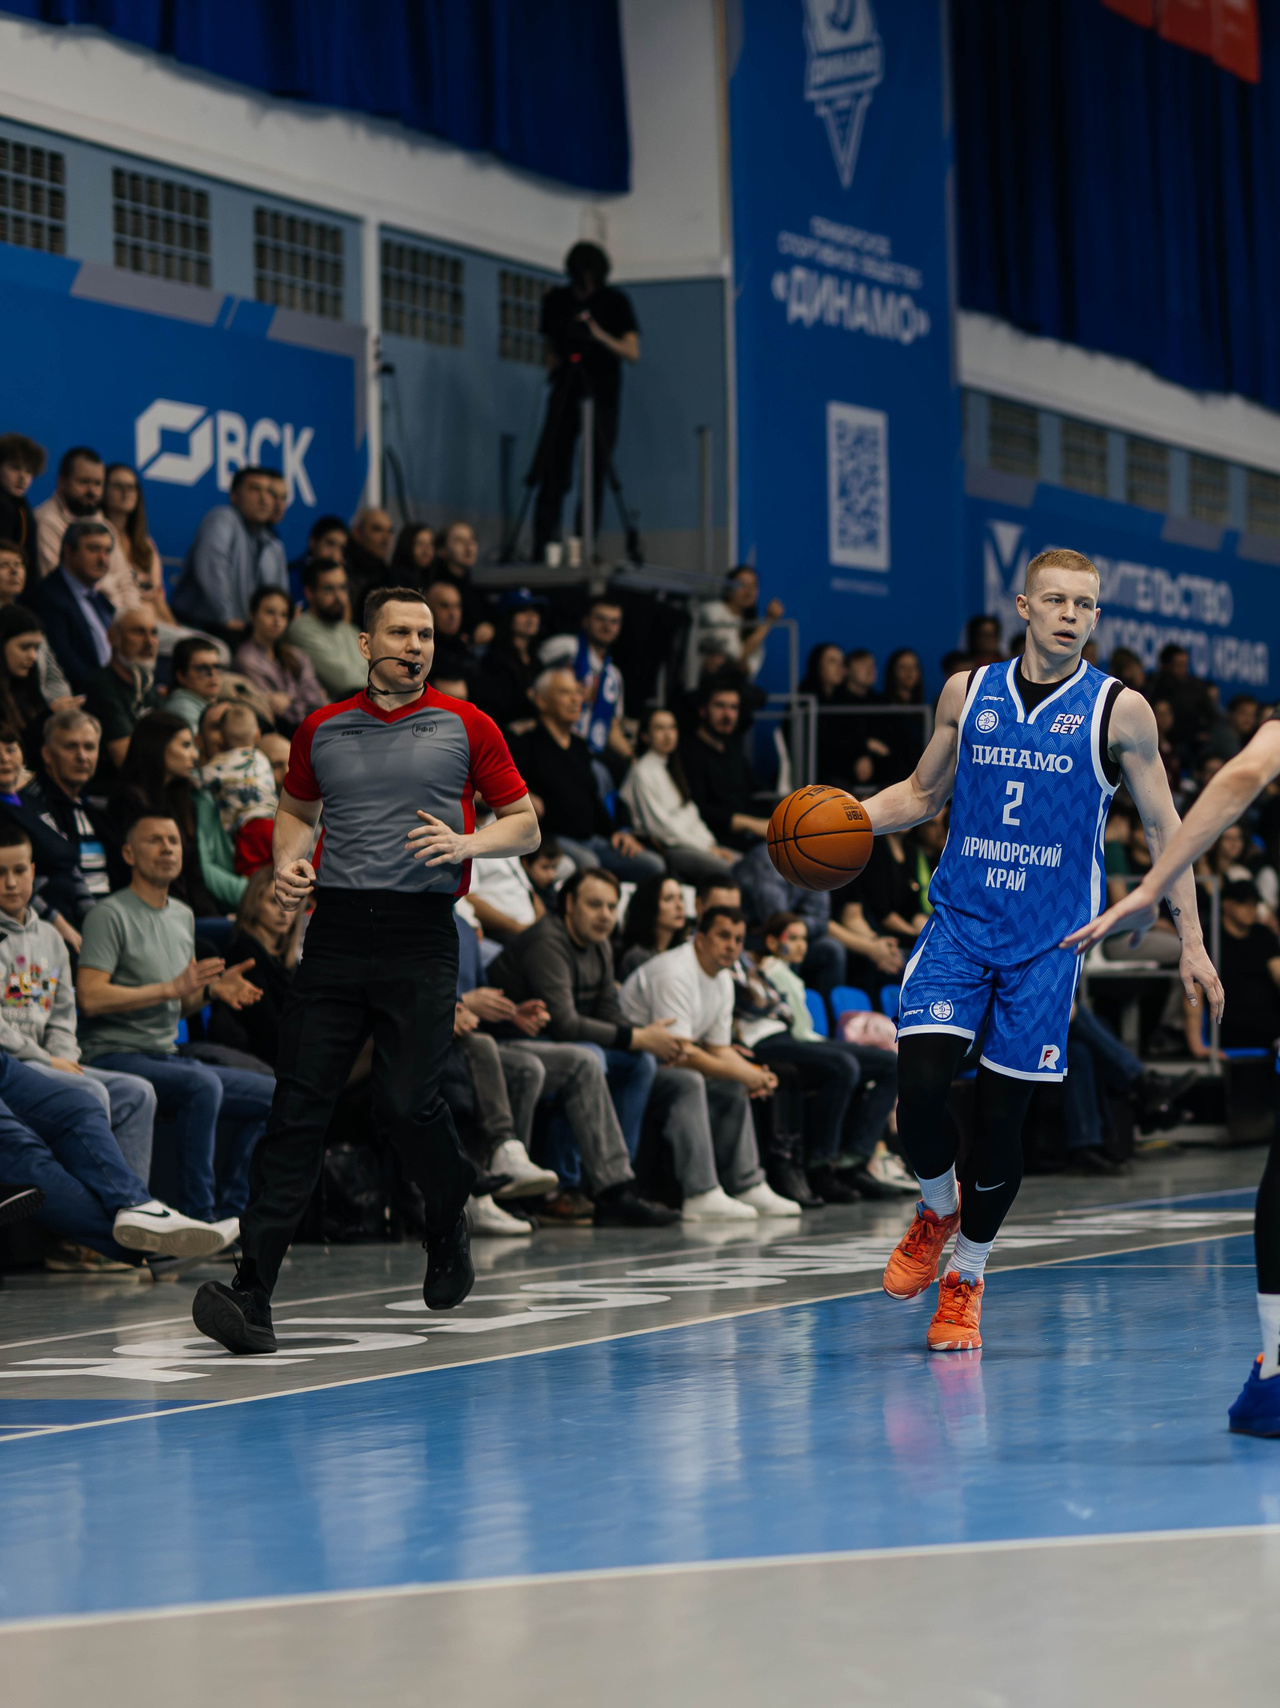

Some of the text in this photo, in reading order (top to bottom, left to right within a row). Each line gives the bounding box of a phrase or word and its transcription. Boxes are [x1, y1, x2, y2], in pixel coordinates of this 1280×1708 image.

[1049, 722, 1081, 735] BET
[1055, 713, 1085, 725] FON
[972, 744, 1073, 774] ДИНАМО
[845, 810, 864, 822] FIBA
[1002, 780, 1025, 827] 2
[960, 836, 1062, 868] ПРИМОРСКИЙ
[985, 867, 1027, 892] КРАЙ
